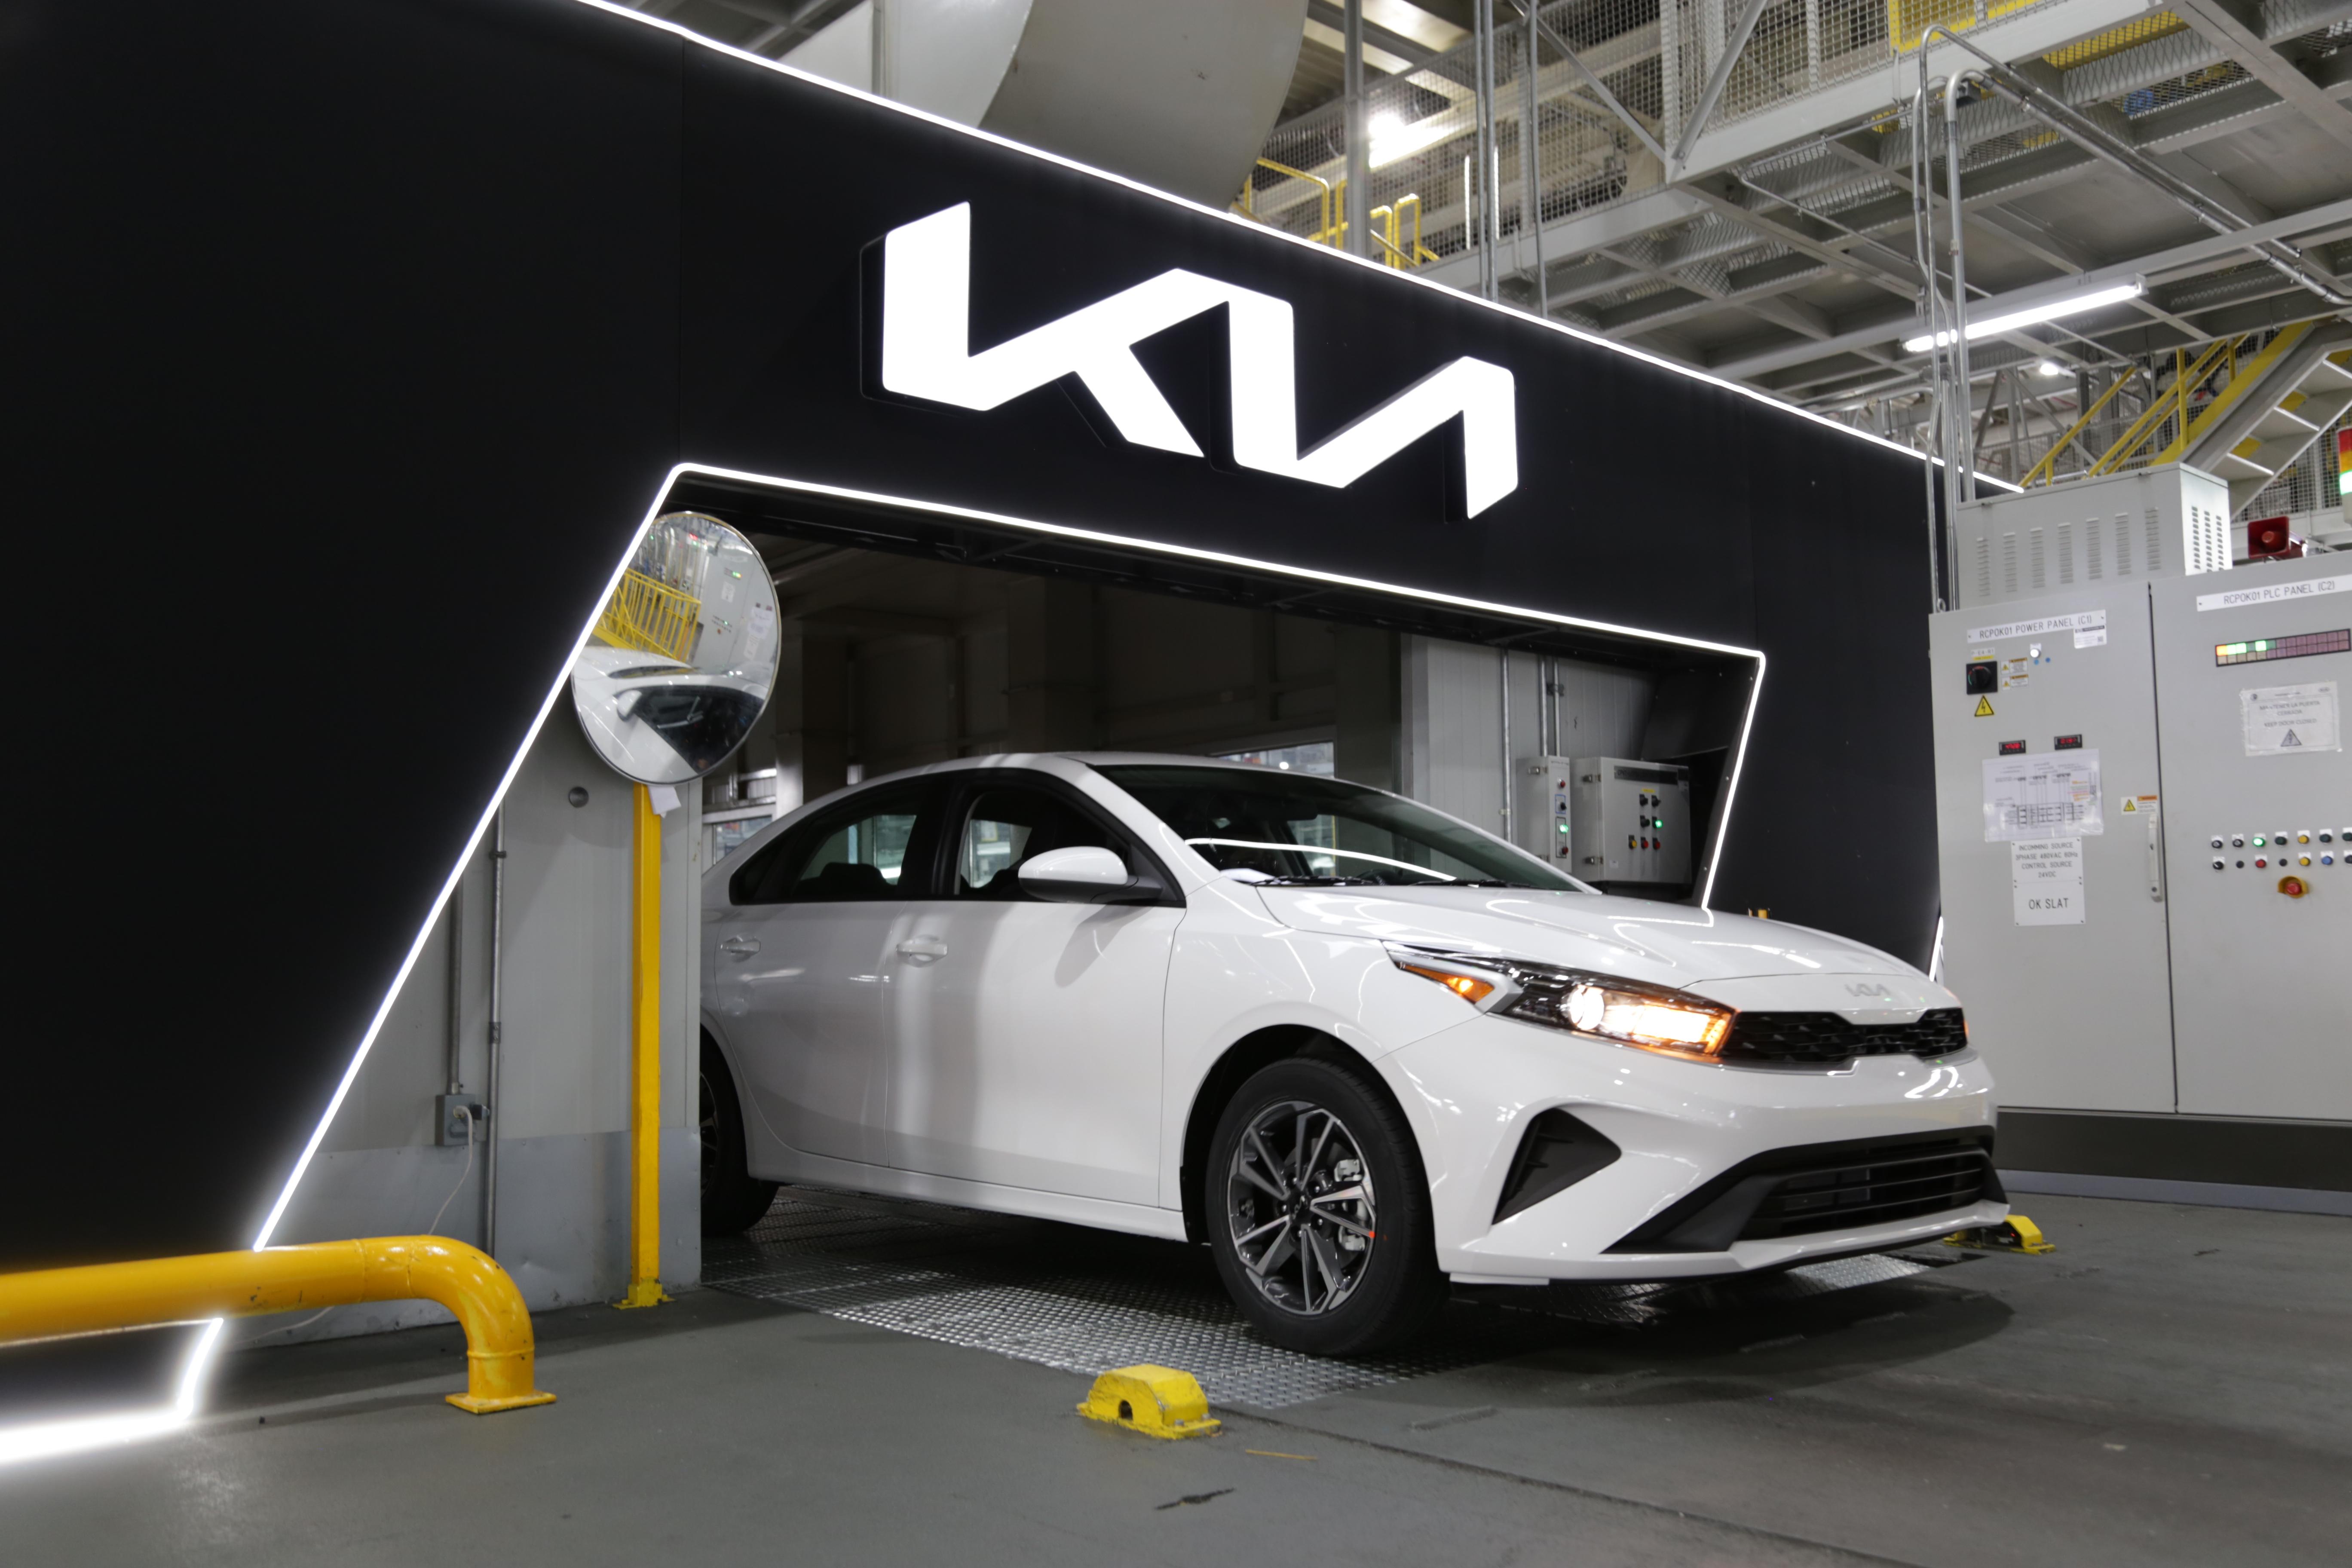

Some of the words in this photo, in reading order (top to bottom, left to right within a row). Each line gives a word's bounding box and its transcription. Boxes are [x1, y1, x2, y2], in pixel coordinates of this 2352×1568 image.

[882, 202, 1518, 519] KIA
[2264, 588, 2280, 599] PLC
[2284, 584, 2314, 596] PANEL
[2318, 581, 2335, 592] (C2)
[2015, 622, 2044, 634] POWER
[2048, 618, 2073, 629] PANEL
[2078, 615, 2092, 626] (C1)
[2028, 899, 2041, 910] OK
[2045, 897, 2068, 909] SLAT
